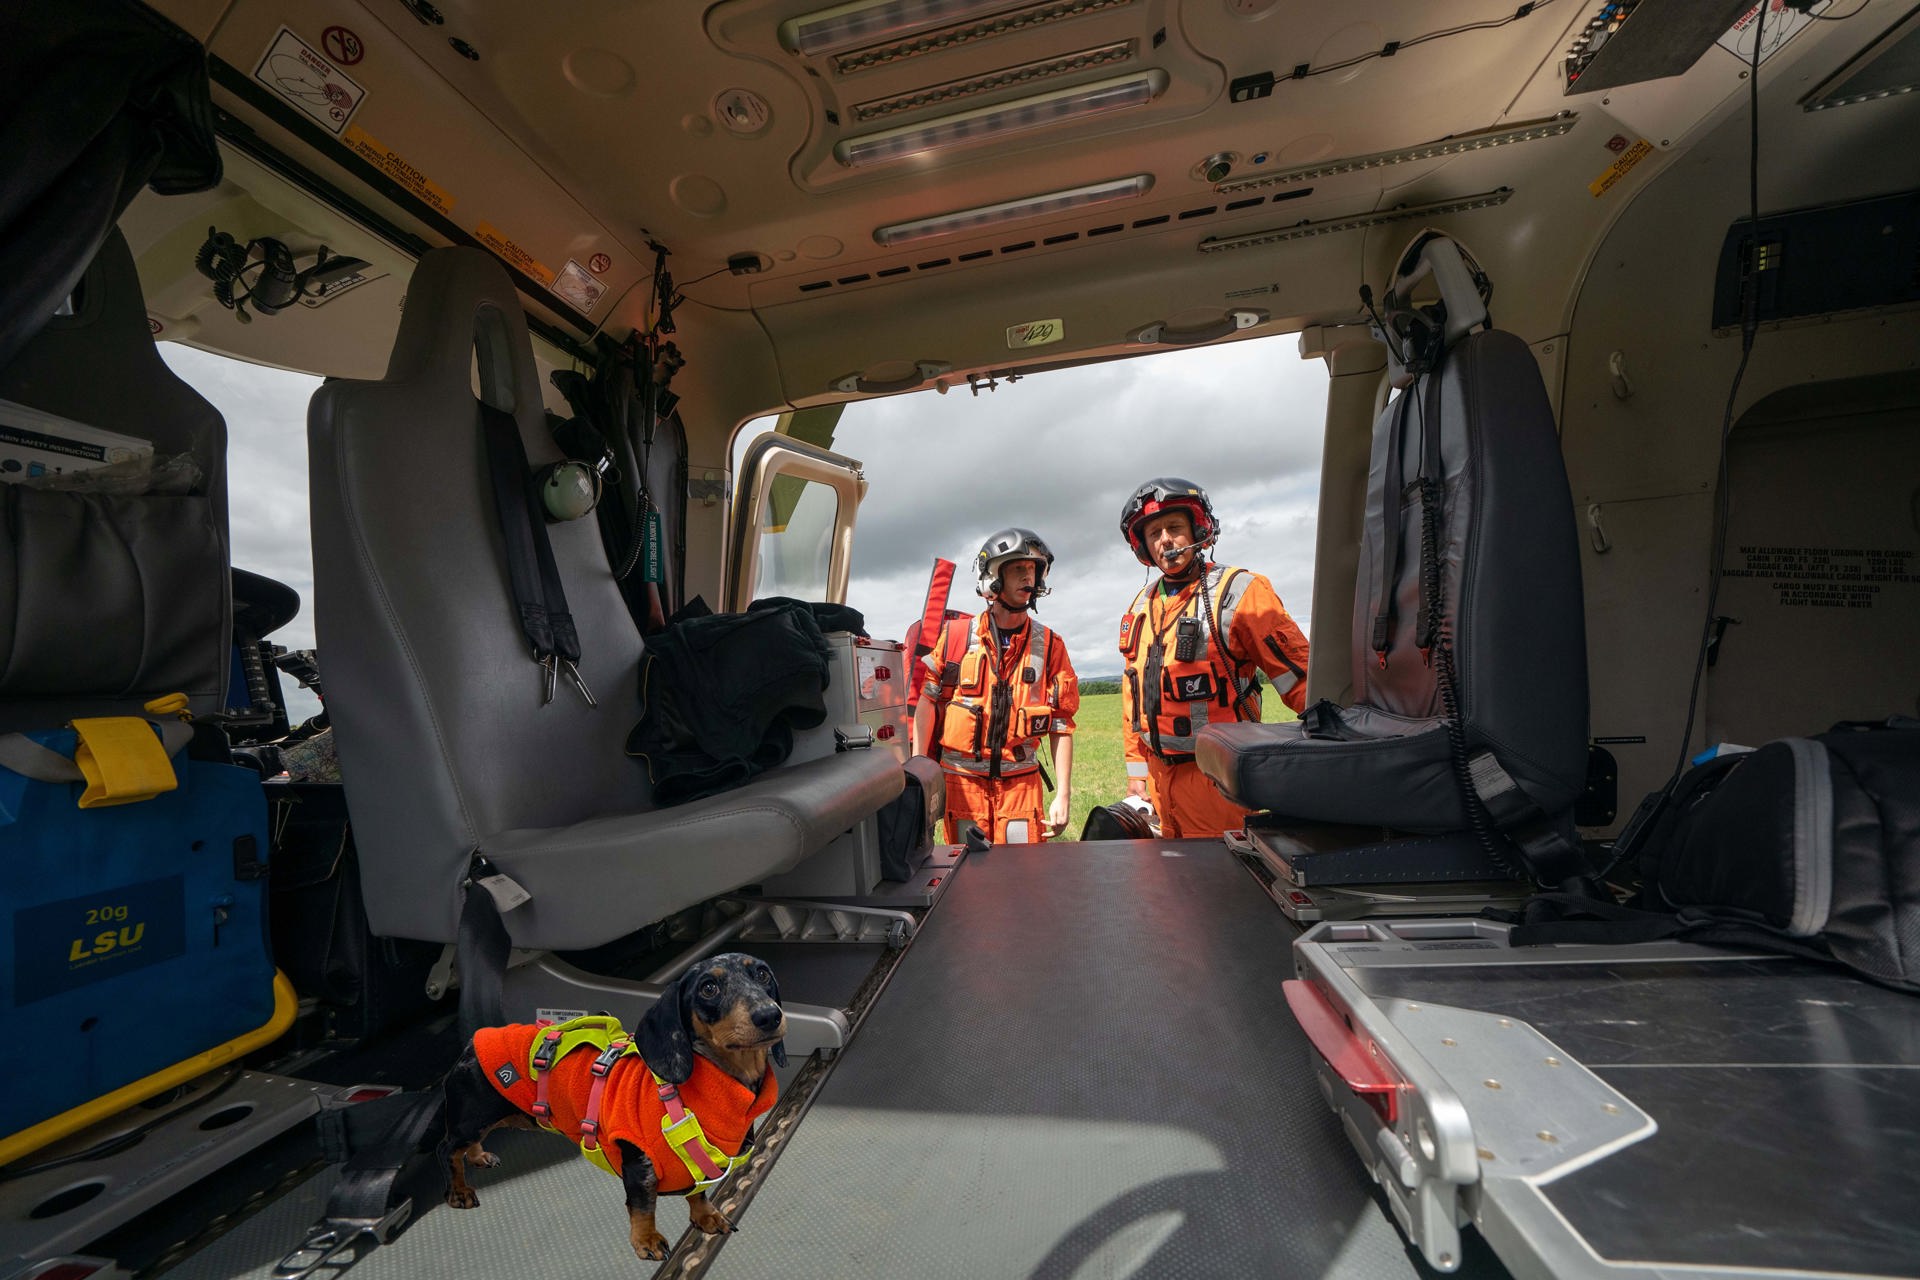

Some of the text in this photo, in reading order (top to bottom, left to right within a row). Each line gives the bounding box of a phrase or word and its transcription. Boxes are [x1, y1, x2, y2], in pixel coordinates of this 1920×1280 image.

[1733, 6, 1760, 31] DANGER
[301, 49, 331, 74] DANGER
[343, 137, 355, 147] NO
[354, 145, 384, 168] OBJECTS
[383, 166, 412, 188] ALLOWED
[358, 141, 385, 162] ENERGY
[384, 159, 425, 190] ATTENUATING
[1613, 141, 1643, 170] CAUTION
[385, 151, 427, 184] CAUTION
[505, 240, 535, 264] CAUTION
[20, 438, 49, 450] SAFETY
[49, 443, 101, 460] INSTRUCTIONS
[649, 542, 657, 561] BEFORE
[1758, 547, 1801, 555] ALLOWABLE
[1804, 548, 1829, 556] FLOOR
[1831, 549, 1864, 557] LOADING
[649, 561, 658, 579] FLIGHT
[1783, 563, 1803, 571] AREA
[1793, 571, 1834, 579] ALLOWABLE
[1836, 573, 1862, 581] CARGO
[1863, 574, 1893, 582] WEIGHT
[1773, 582, 1800, 590] CARGO
[1841, 584, 1880, 592] SECURED
[1781, 590, 1872, 601] IN ACCORDANCE WITH
[1780, 598, 1808, 606] FLIGHT
[1810, 599, 1845, 608] MANUAL
[85, 905, 129, 925] 20g
[69, 921, 145, 962] LSU
